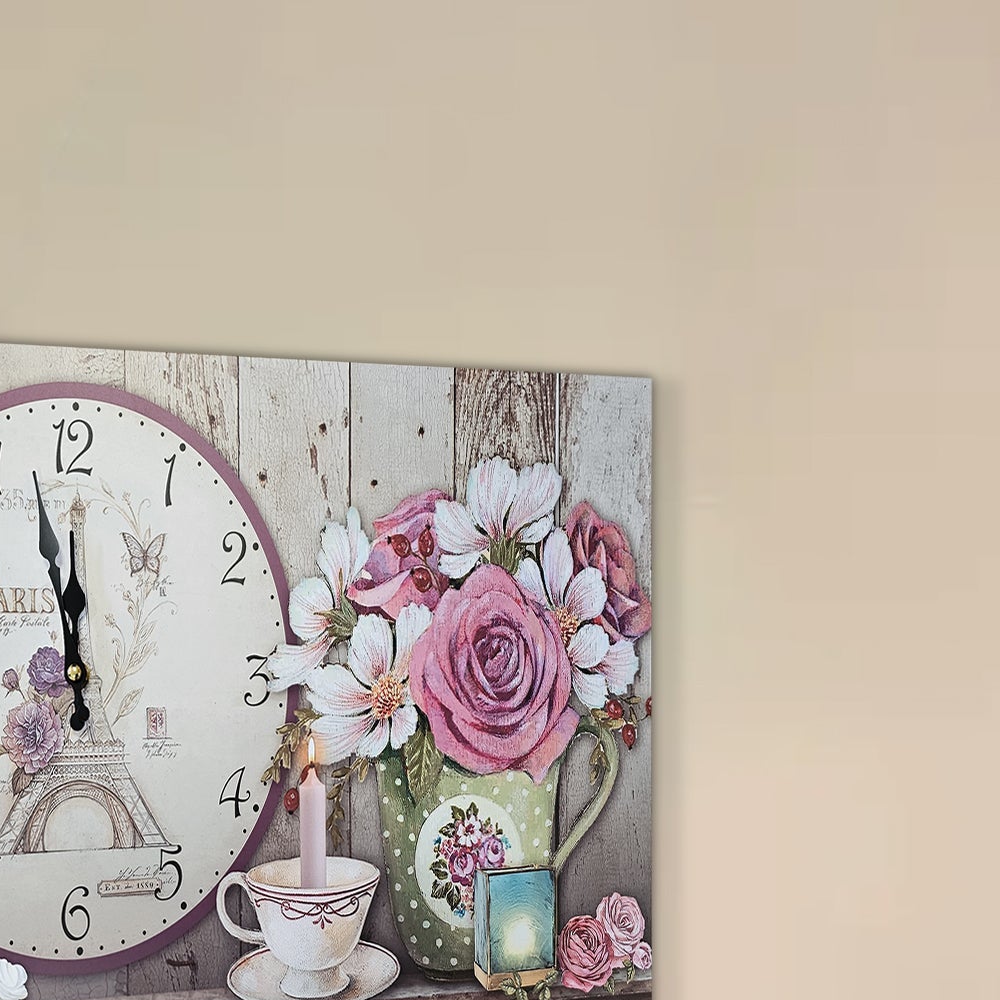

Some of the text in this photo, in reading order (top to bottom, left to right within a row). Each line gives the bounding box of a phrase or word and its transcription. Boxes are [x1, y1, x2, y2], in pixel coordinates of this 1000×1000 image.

[52, 418, 94, 477] 12
[164, 453, 178, 508] 1
[221, 531, 247, 586] 2
[243, 654, 271, 707] 3
[218, 766, 251, 819] 4
[153, 844, 183, 901] 5
[60, 885, 91, 942] 6
